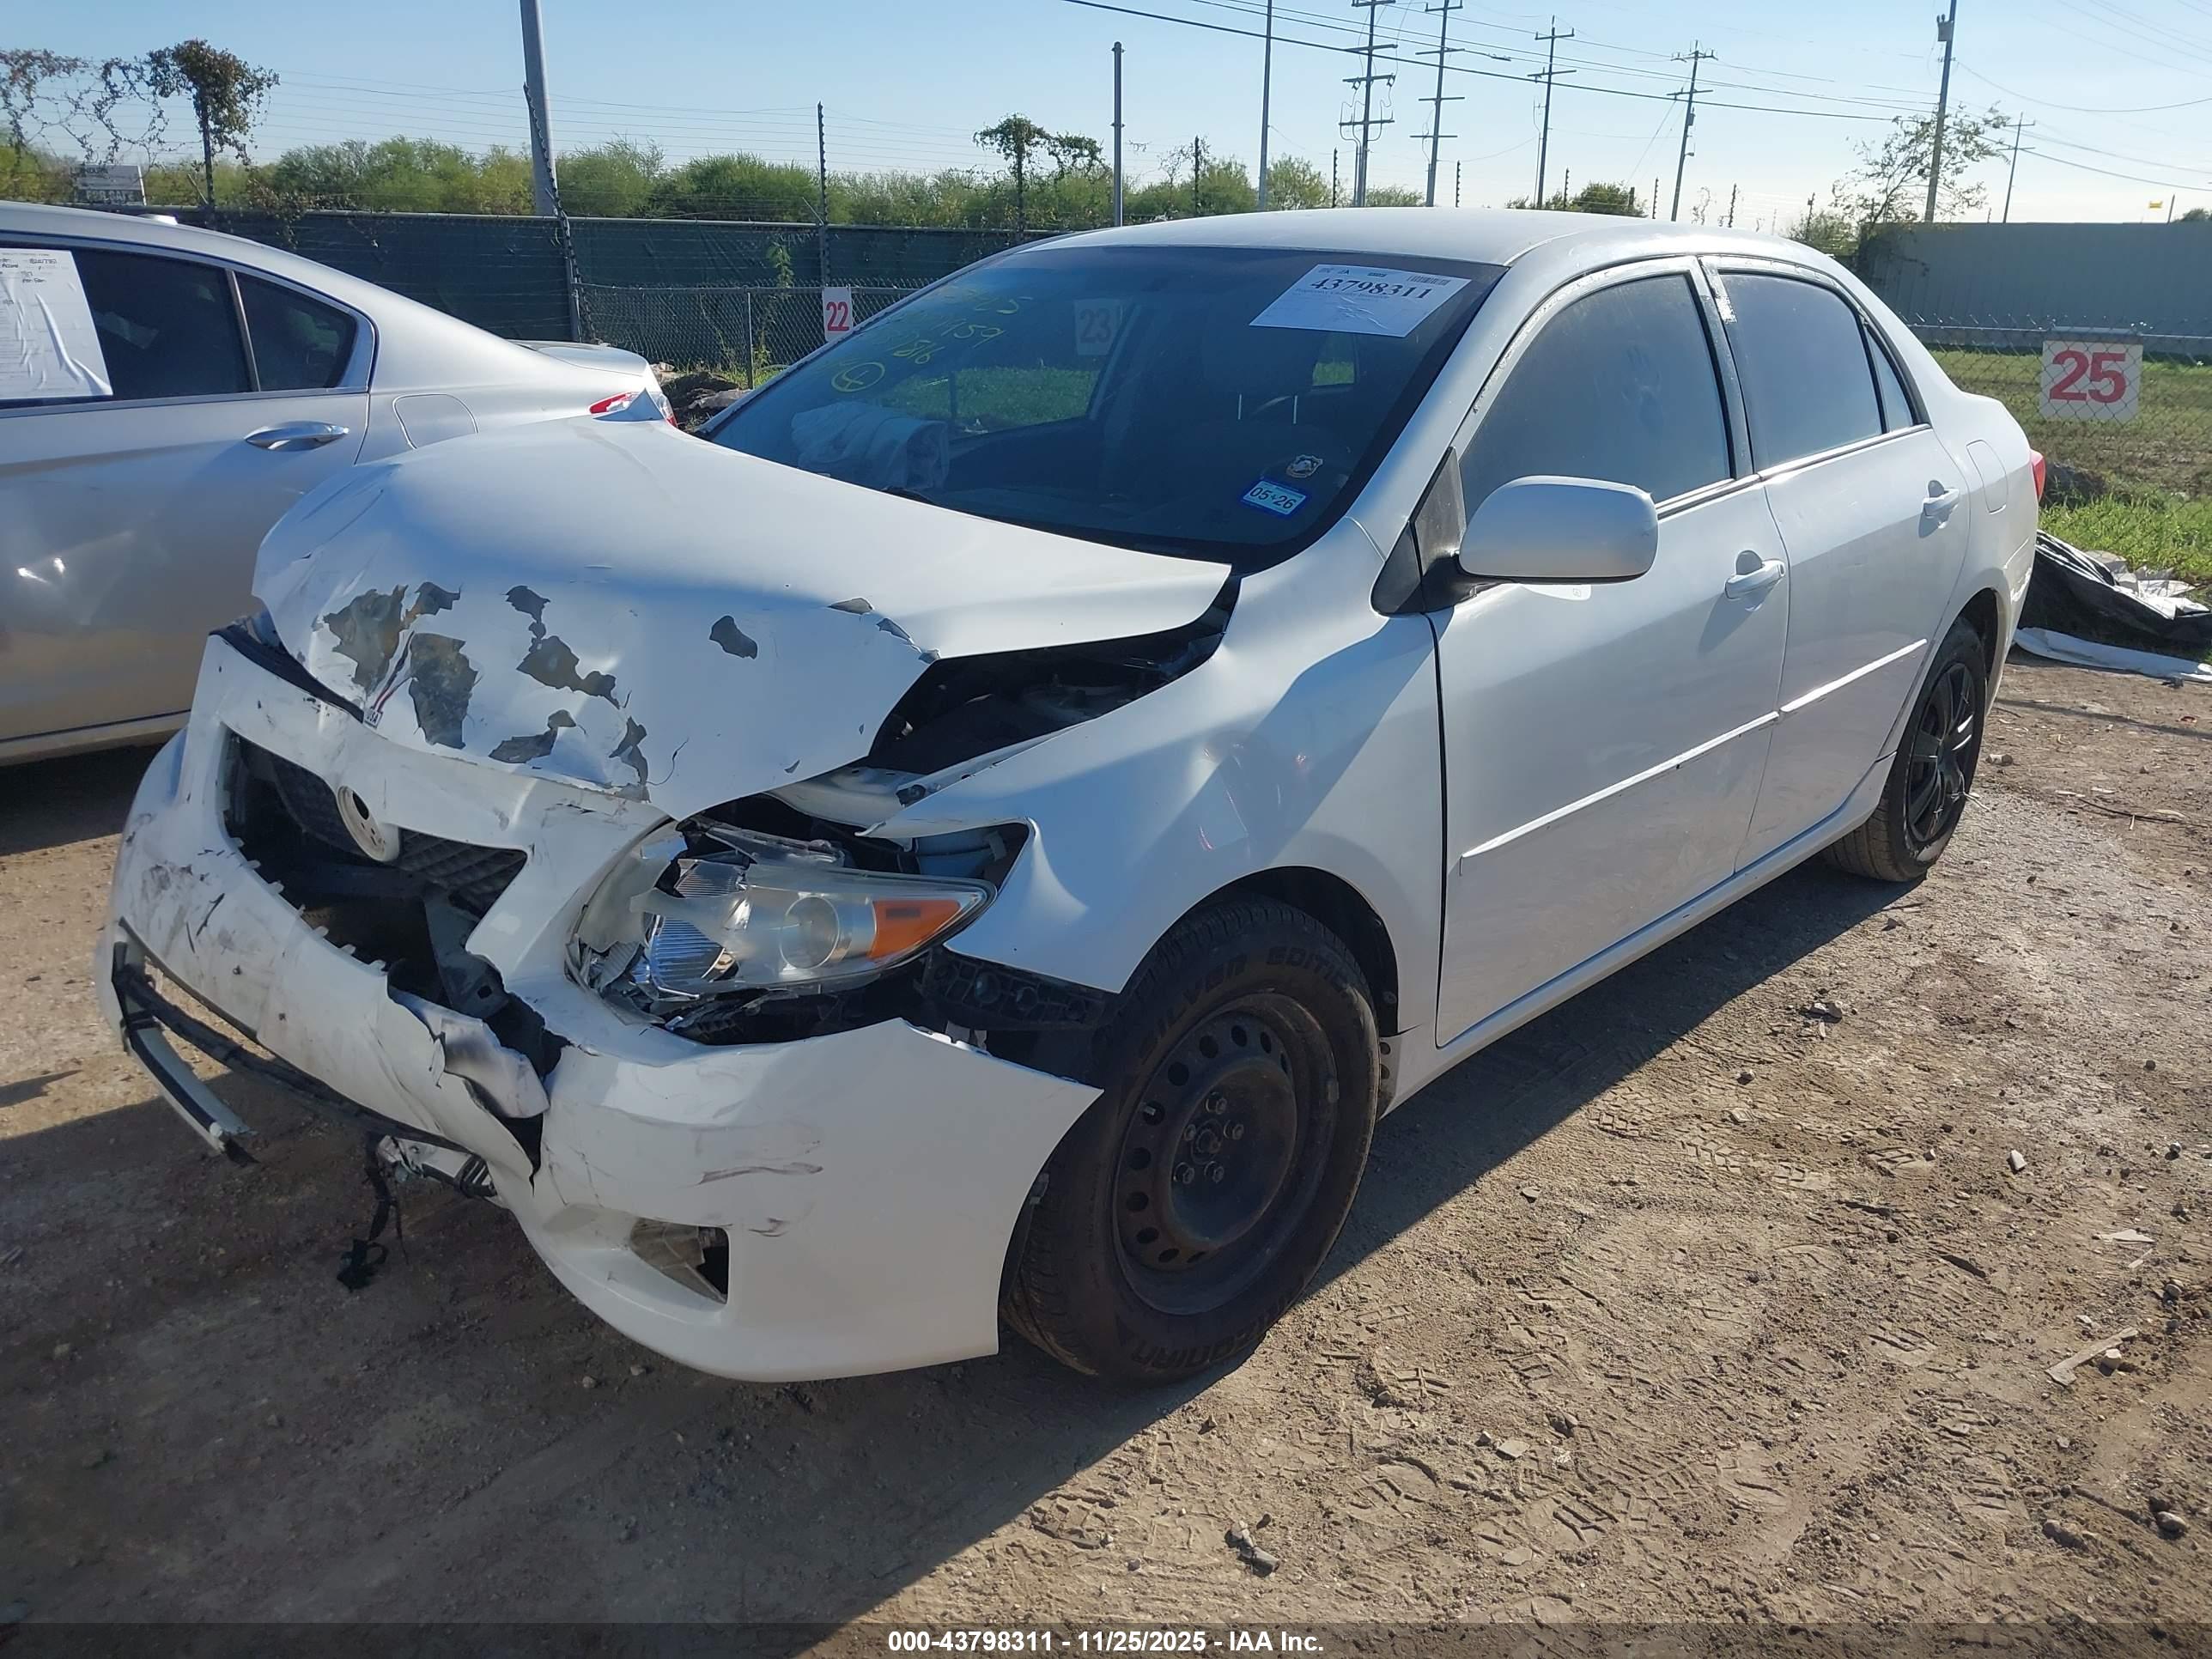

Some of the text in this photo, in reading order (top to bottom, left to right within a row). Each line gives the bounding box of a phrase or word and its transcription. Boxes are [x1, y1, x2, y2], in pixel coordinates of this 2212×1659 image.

[1311, 278, 1432, 299] 43798311
[825, 301, 850, 331] 22
[1079, 308, 1113, 343] 23
[2050, 349, 2127, 404] 25
